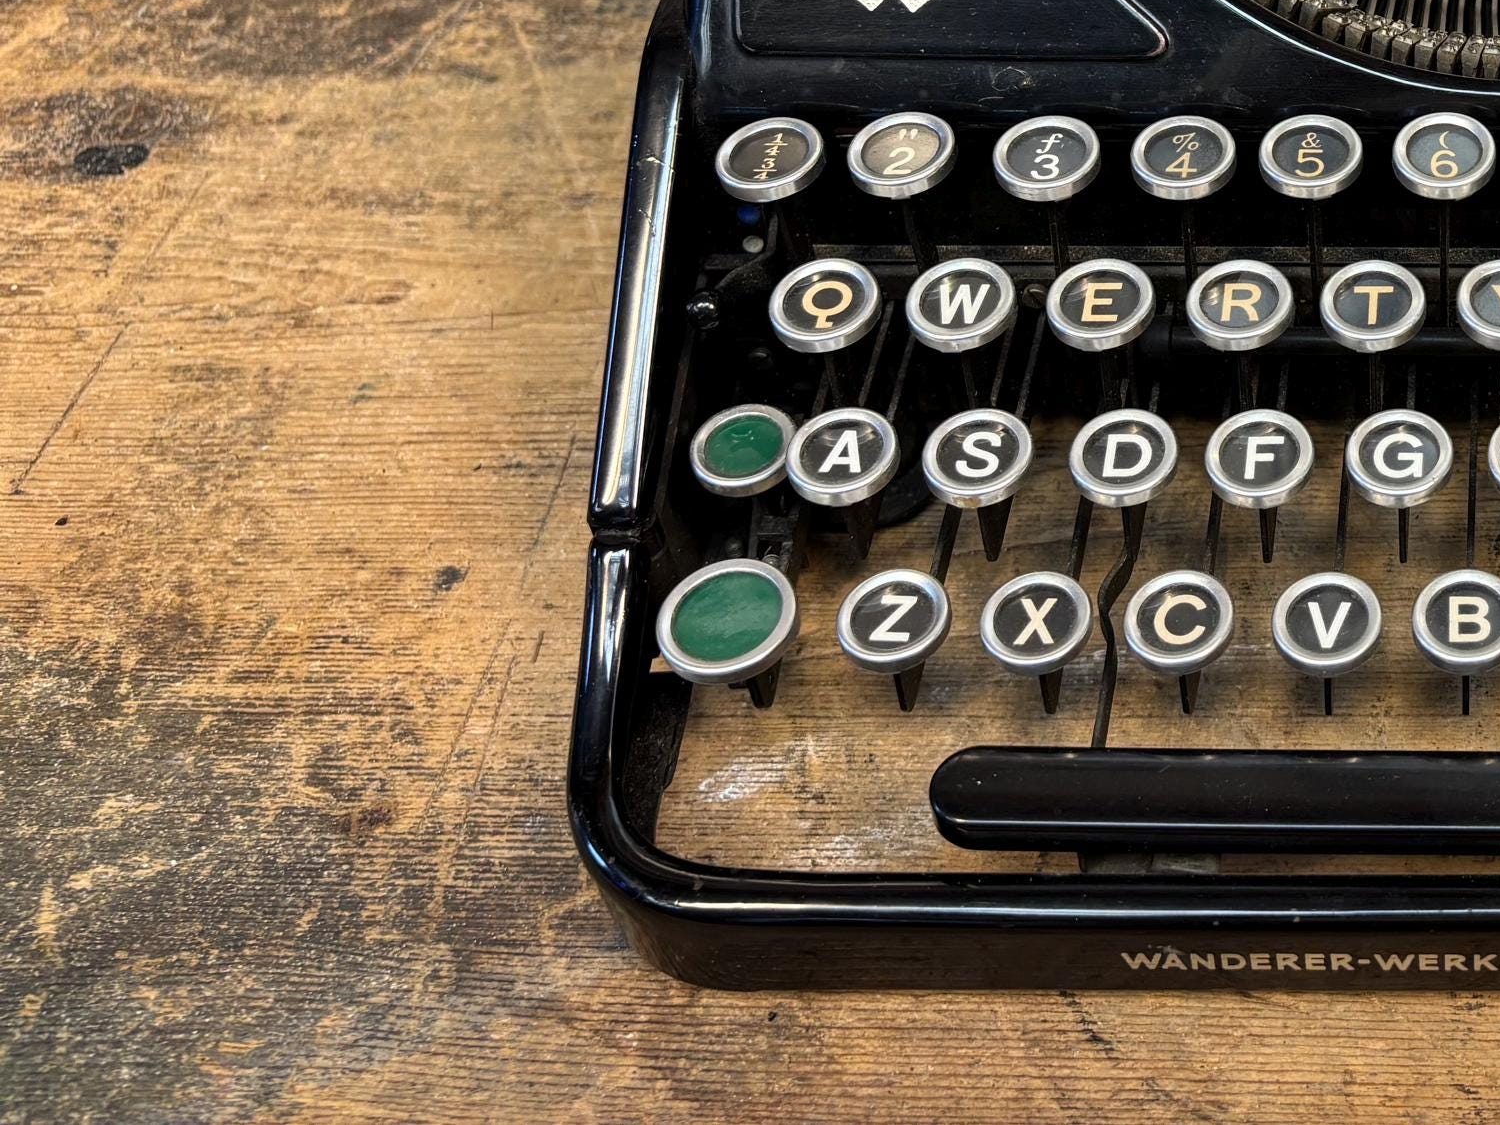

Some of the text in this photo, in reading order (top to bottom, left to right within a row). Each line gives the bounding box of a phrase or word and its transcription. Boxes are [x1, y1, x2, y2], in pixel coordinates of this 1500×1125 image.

[883, 146, 915, 175] 2
[1031, 154, 1059, 179] 3
[1166, 153, 1197, 179] 4
[1295, 149, 1324, 177] 5
[1431, 150, 1458, 178] 6
[1173, 133, 1199, 152] %
[1301, 133, 1321, 149] &
[802, 281, 853, 329] Q
[939, 283, 991, 325] W
[1081, 282, 1122, 322] E
[1221, 283, 1261, 321] R
[1354, 286, 1393, 324] T
[819, 430, 861, 473] A
[956, 433, 1002, 477] S
[1102, 433, 1152, 477] D
[1244, 436, 1285, 480] F
[1374, 432, 1423, 478] G
[869, 594, 918, 642] Z
[1013, 597, 1058, 645] X
[1154, 595, 1206, 644] C
[1308, 602, 1351, 648] V
[1449, 596, 1491, 642] B
